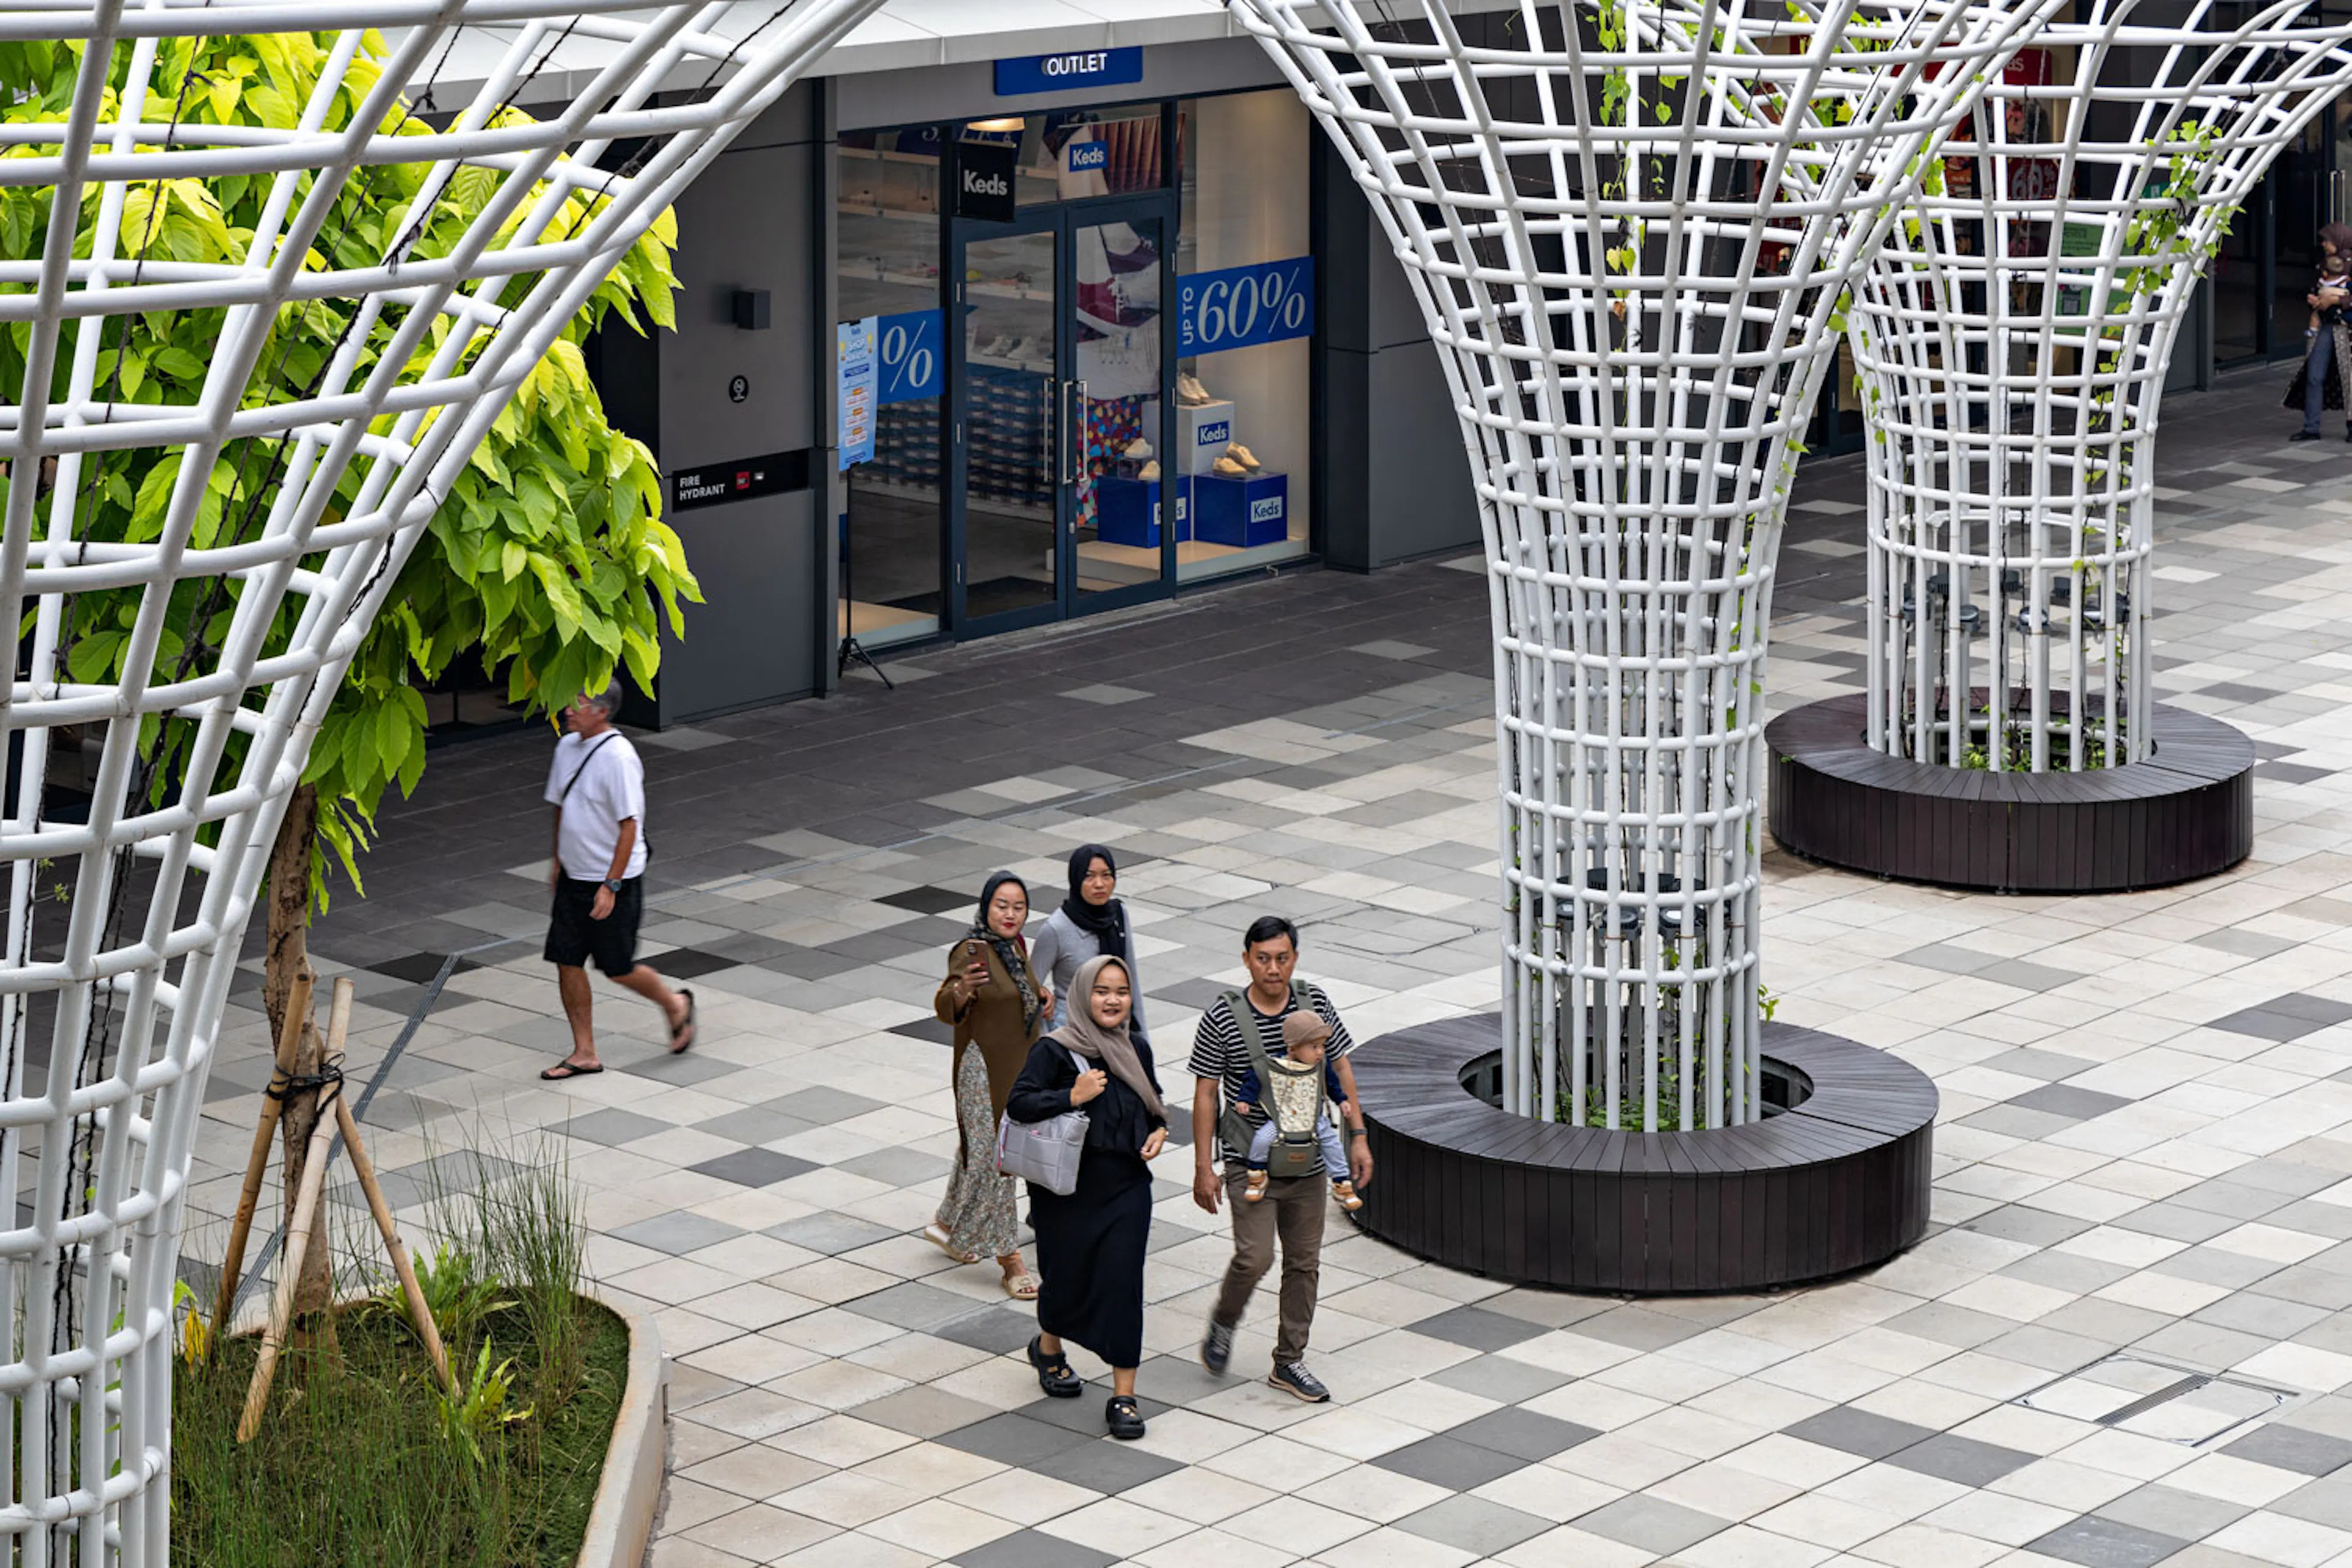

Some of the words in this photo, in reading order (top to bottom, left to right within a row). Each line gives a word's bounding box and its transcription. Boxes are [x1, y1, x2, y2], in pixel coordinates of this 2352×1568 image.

[1046, 52, 1108, 77] OUTLET
[1073, 146, 1104, 167] Keds
[963, 168, 1008, 196] Keds
[1182, 286, 1194, 315] TO
[1197, 263, 1306, 344] 60%
[1182, 318, 1194, 345] UP
[1199, 423, 1227, 444] Keds
[679, 474, 701, 488] FIRE
[679, 482, 726, 502] HYDRANT
[1254, 500, 1280, 519] Keds
